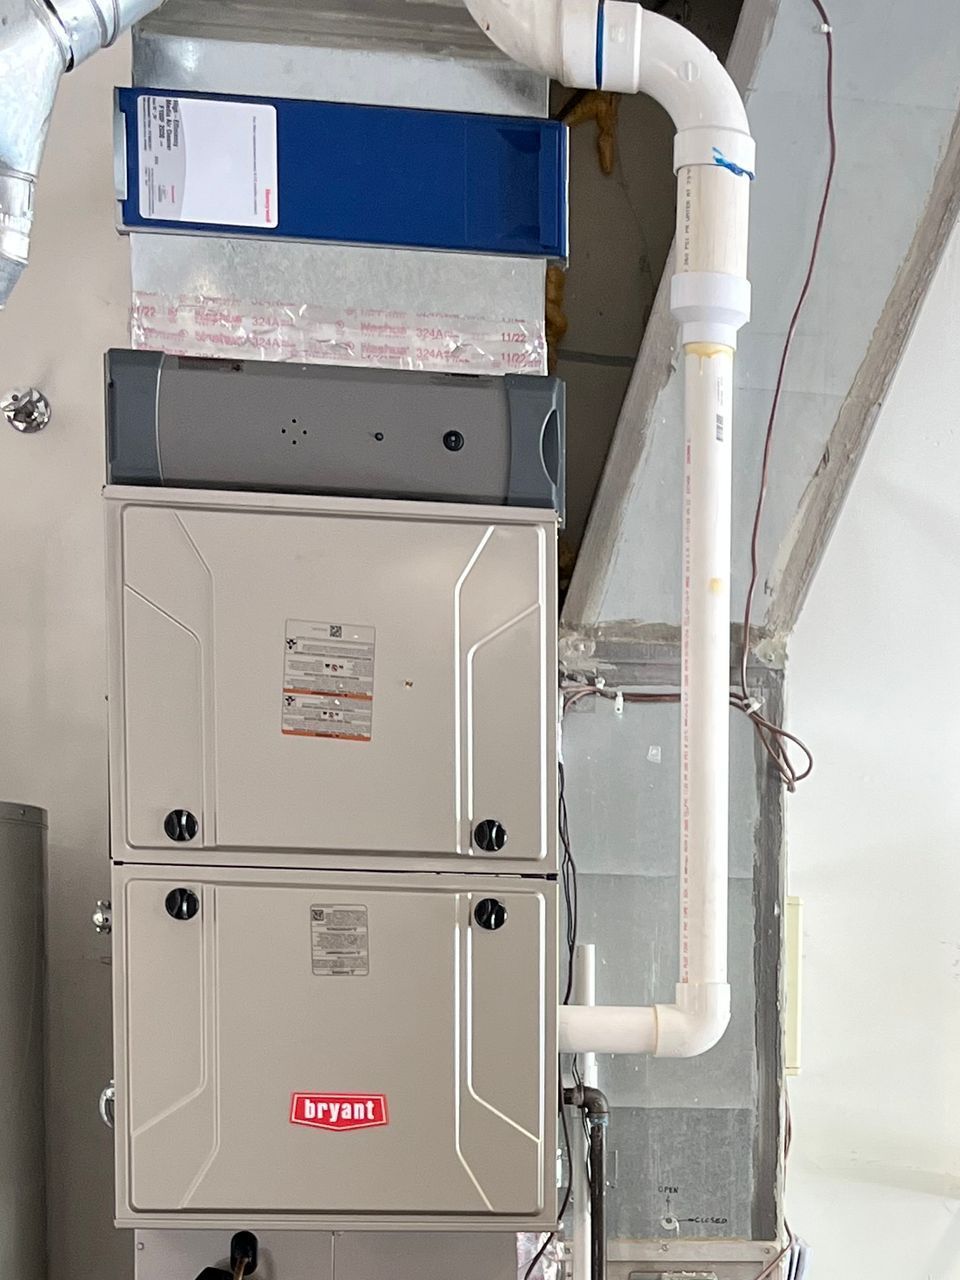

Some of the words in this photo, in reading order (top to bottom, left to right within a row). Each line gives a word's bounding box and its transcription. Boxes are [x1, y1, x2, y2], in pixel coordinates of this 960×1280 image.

[416, 327, 444, 339] 324A
[501, 332, 526, 344] 11/22
[416, 347, 444, 360] 324A
[304, 1098, 375, 1123] bryant
[658, 1186, 679, 1194] OPEN
[694, 1216, 728, 1224] CLOSED
